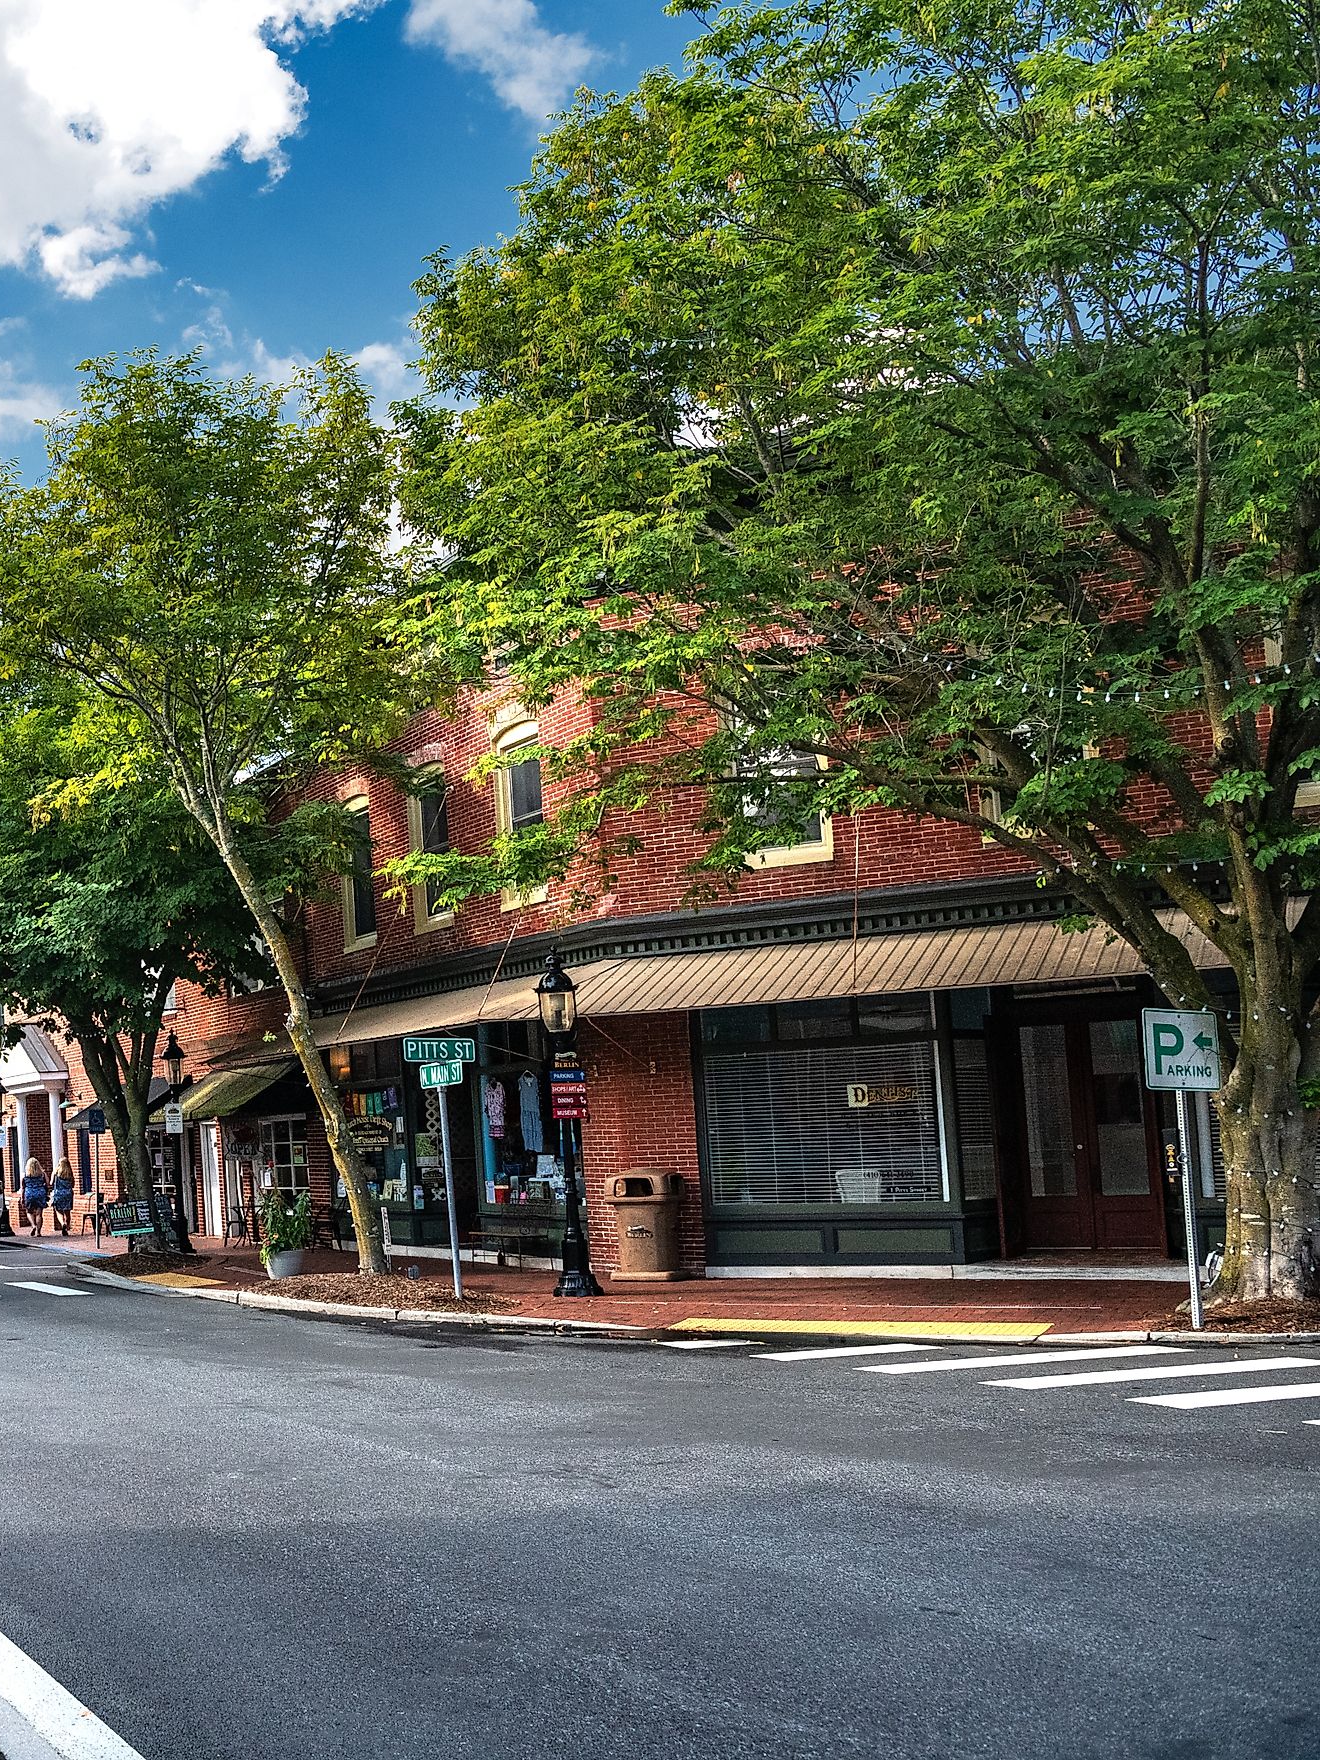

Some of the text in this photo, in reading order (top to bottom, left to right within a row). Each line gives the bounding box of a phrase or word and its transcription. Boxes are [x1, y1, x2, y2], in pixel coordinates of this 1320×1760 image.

[407, 1041, 471, 1059] PITTS ST
[421, 1062, 460, 1085] N. MAIN ST
[852, 1086, 918, 1103] DENTIST
